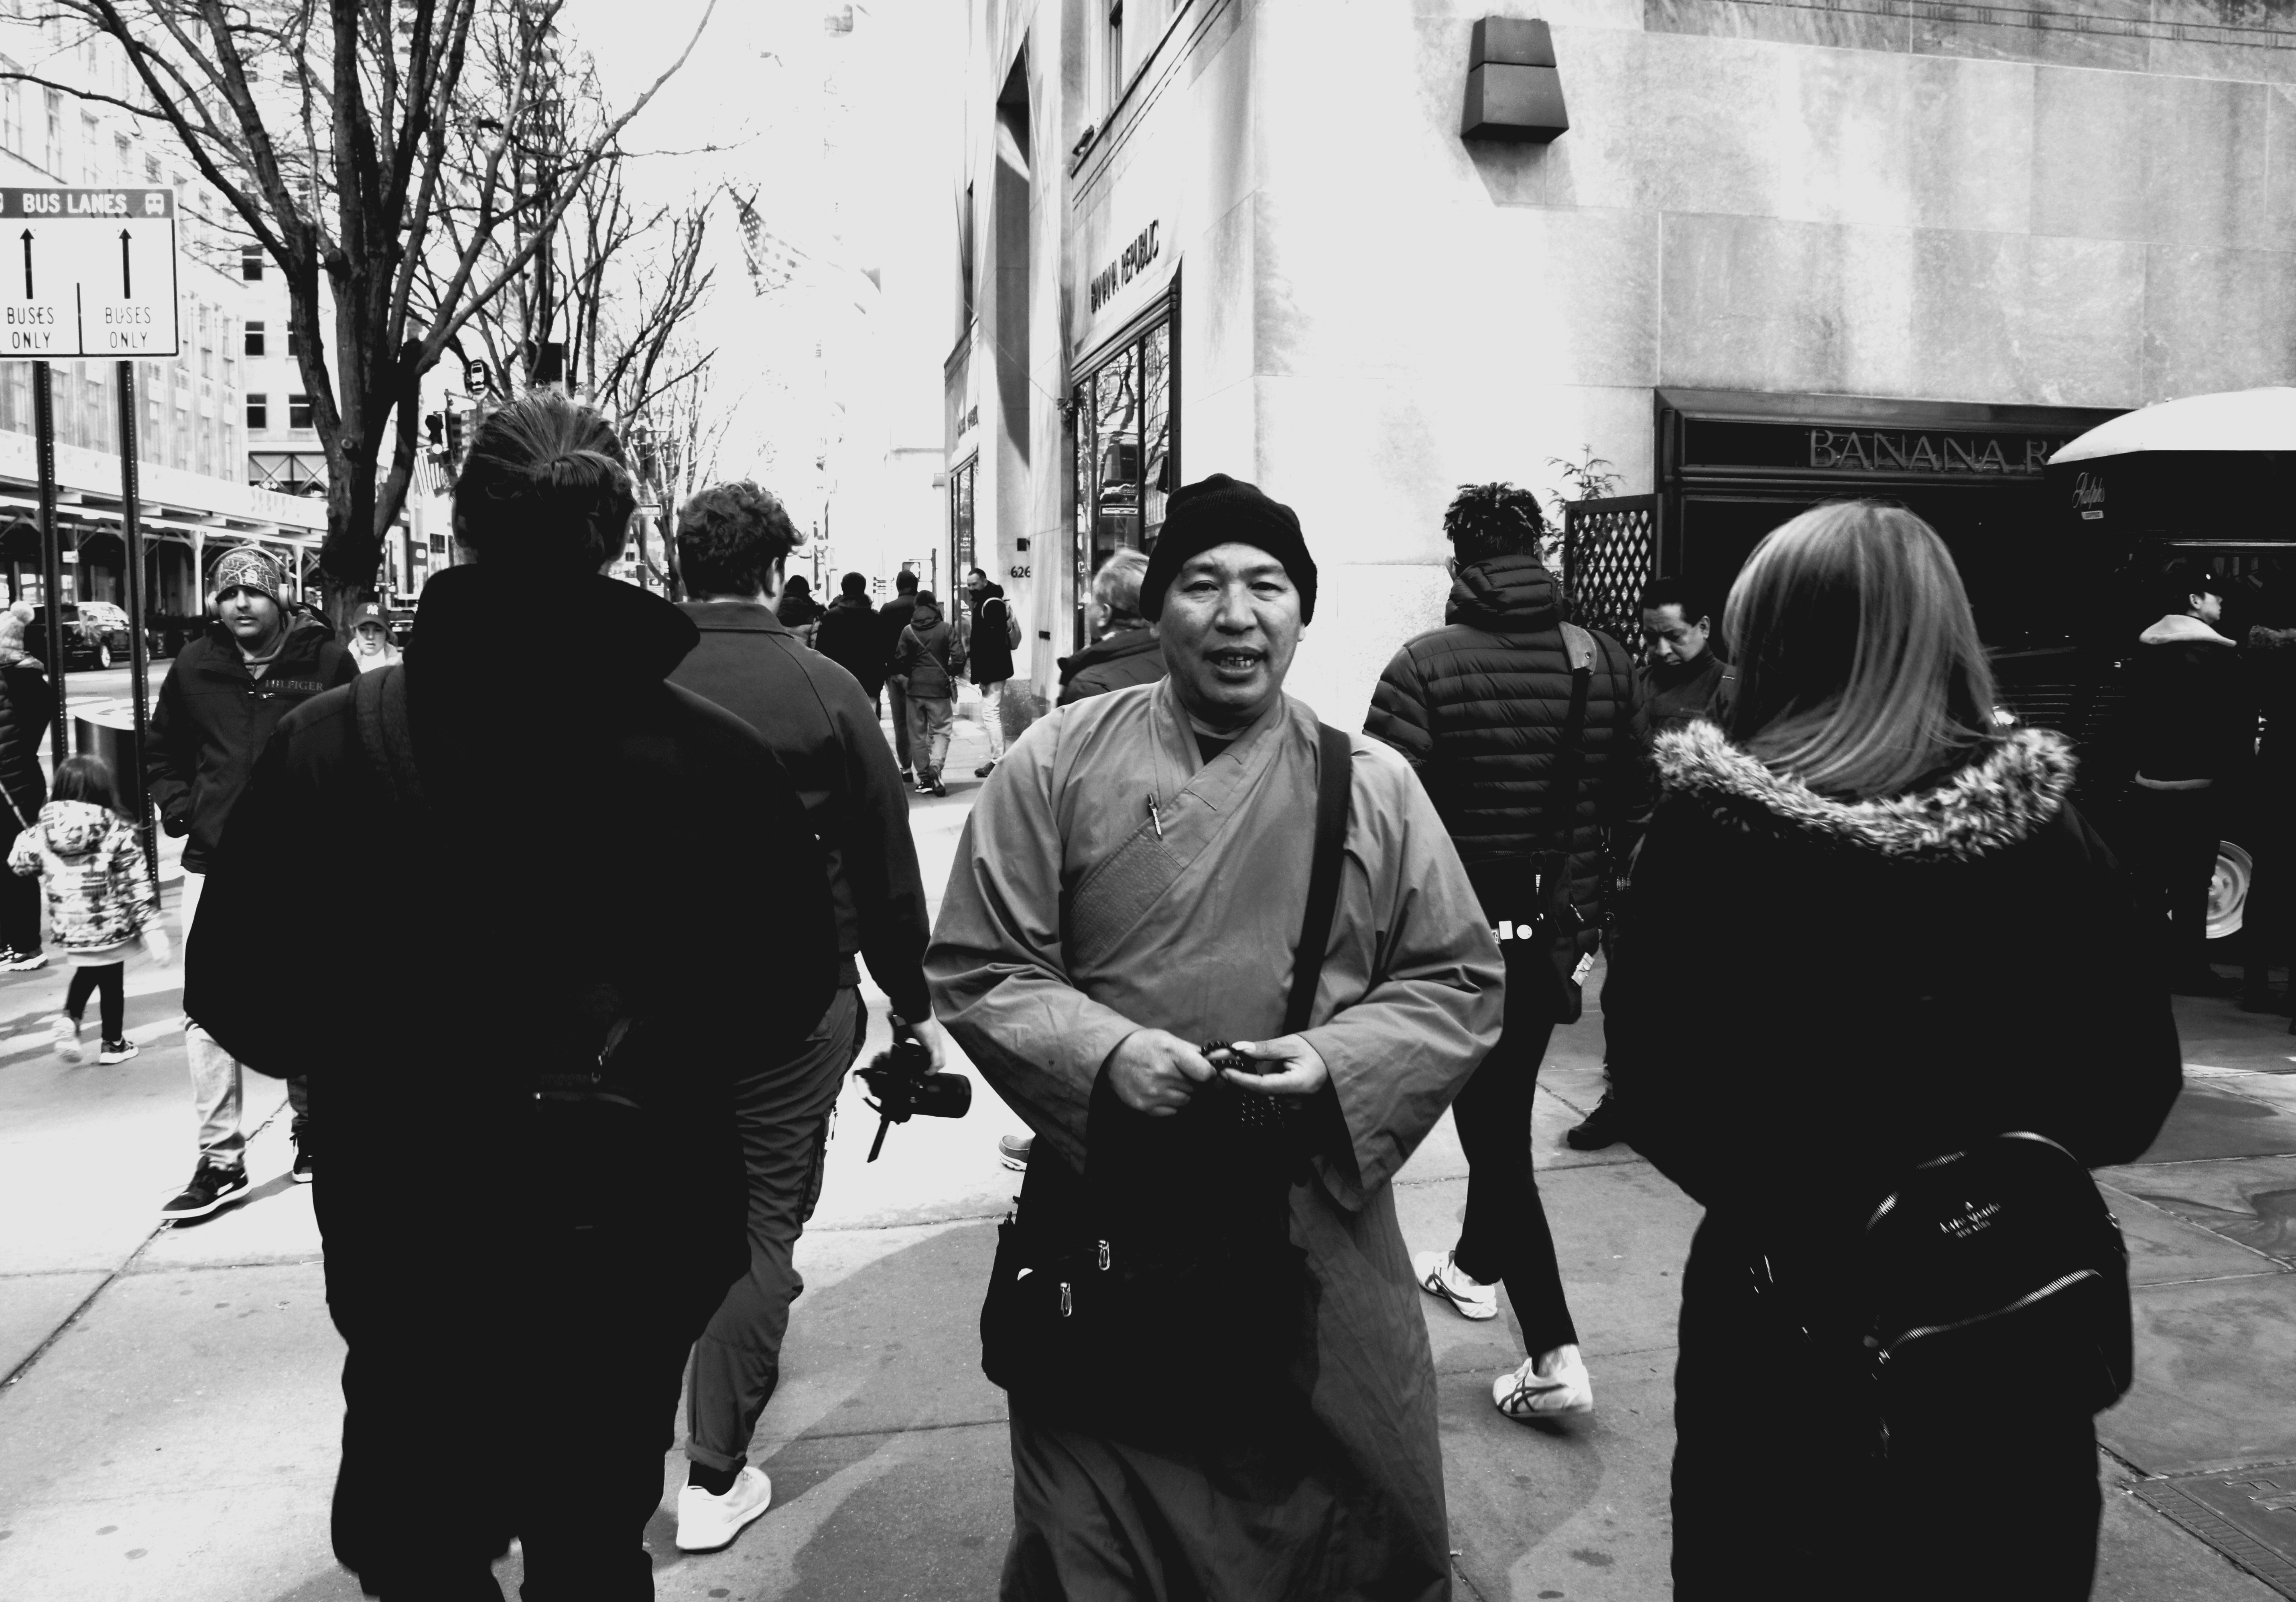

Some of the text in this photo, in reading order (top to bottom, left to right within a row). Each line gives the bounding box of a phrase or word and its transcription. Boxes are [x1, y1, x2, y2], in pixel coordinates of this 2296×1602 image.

[23, 193, 127, 213] BUS LANES
[7, 307, 54, 325] BUSES
[105, 307, 151, 324] BUSES
[12, 331, 51, 349] ONLY
[110, 331, 148, 348] ONLY
[1810, 428, 2008, 473] BANANA
[1010, 566, 1030, 578] 626
[266, 679, 323, 691] HILFIGER
